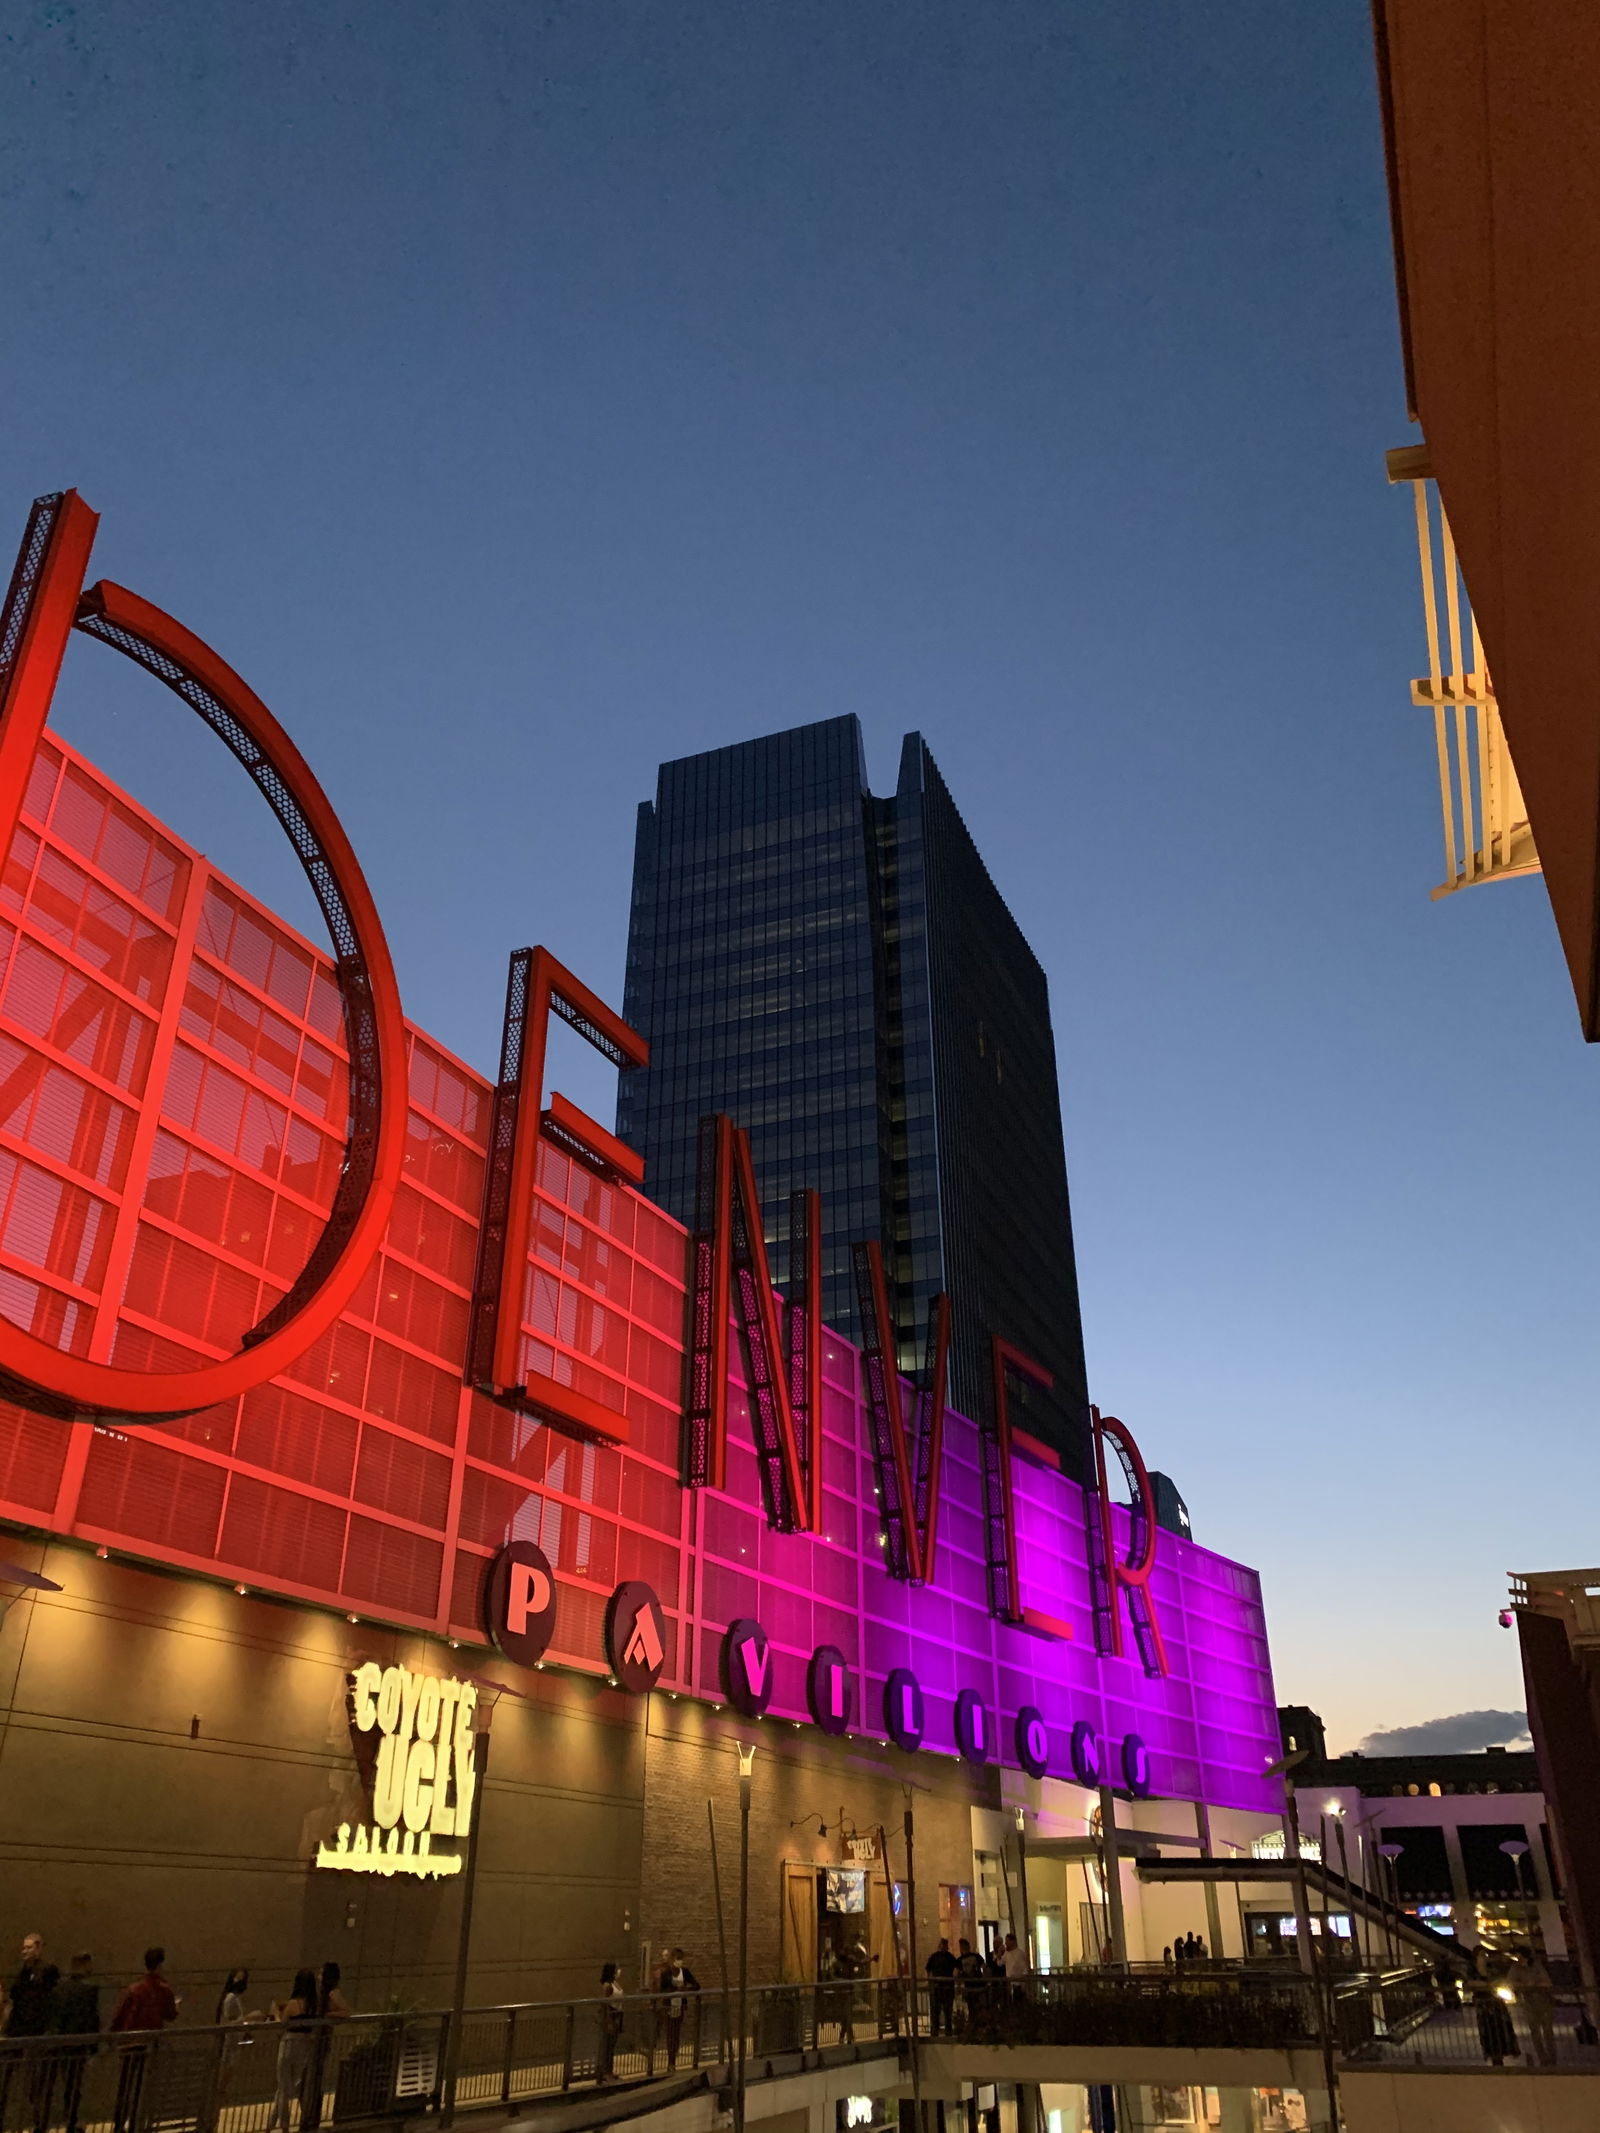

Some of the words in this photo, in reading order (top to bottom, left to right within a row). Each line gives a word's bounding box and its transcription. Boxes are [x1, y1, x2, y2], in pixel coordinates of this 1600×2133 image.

[0, 487, 1169, 1679] DENVER
[353, 1662, 478, 1750] COYOTE
[507, 1562, 1147, 1784] PAVILIONS
[373, 1736, 476, 1837] UGLY
